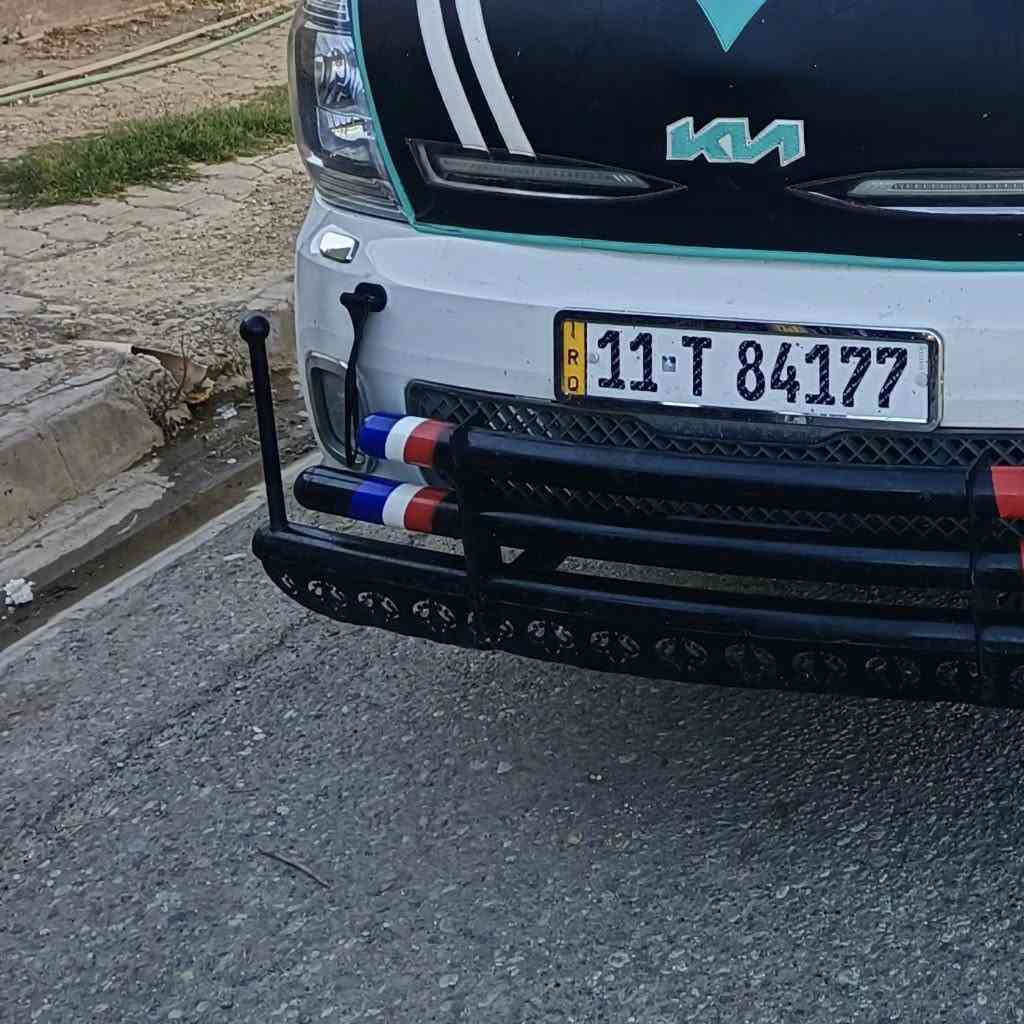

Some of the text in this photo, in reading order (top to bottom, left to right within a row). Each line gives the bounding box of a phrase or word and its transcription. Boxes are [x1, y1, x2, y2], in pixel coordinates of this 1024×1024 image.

[666, 116, 805, 167] KIA
[597, 329, 909, 409] 11 T 84177
